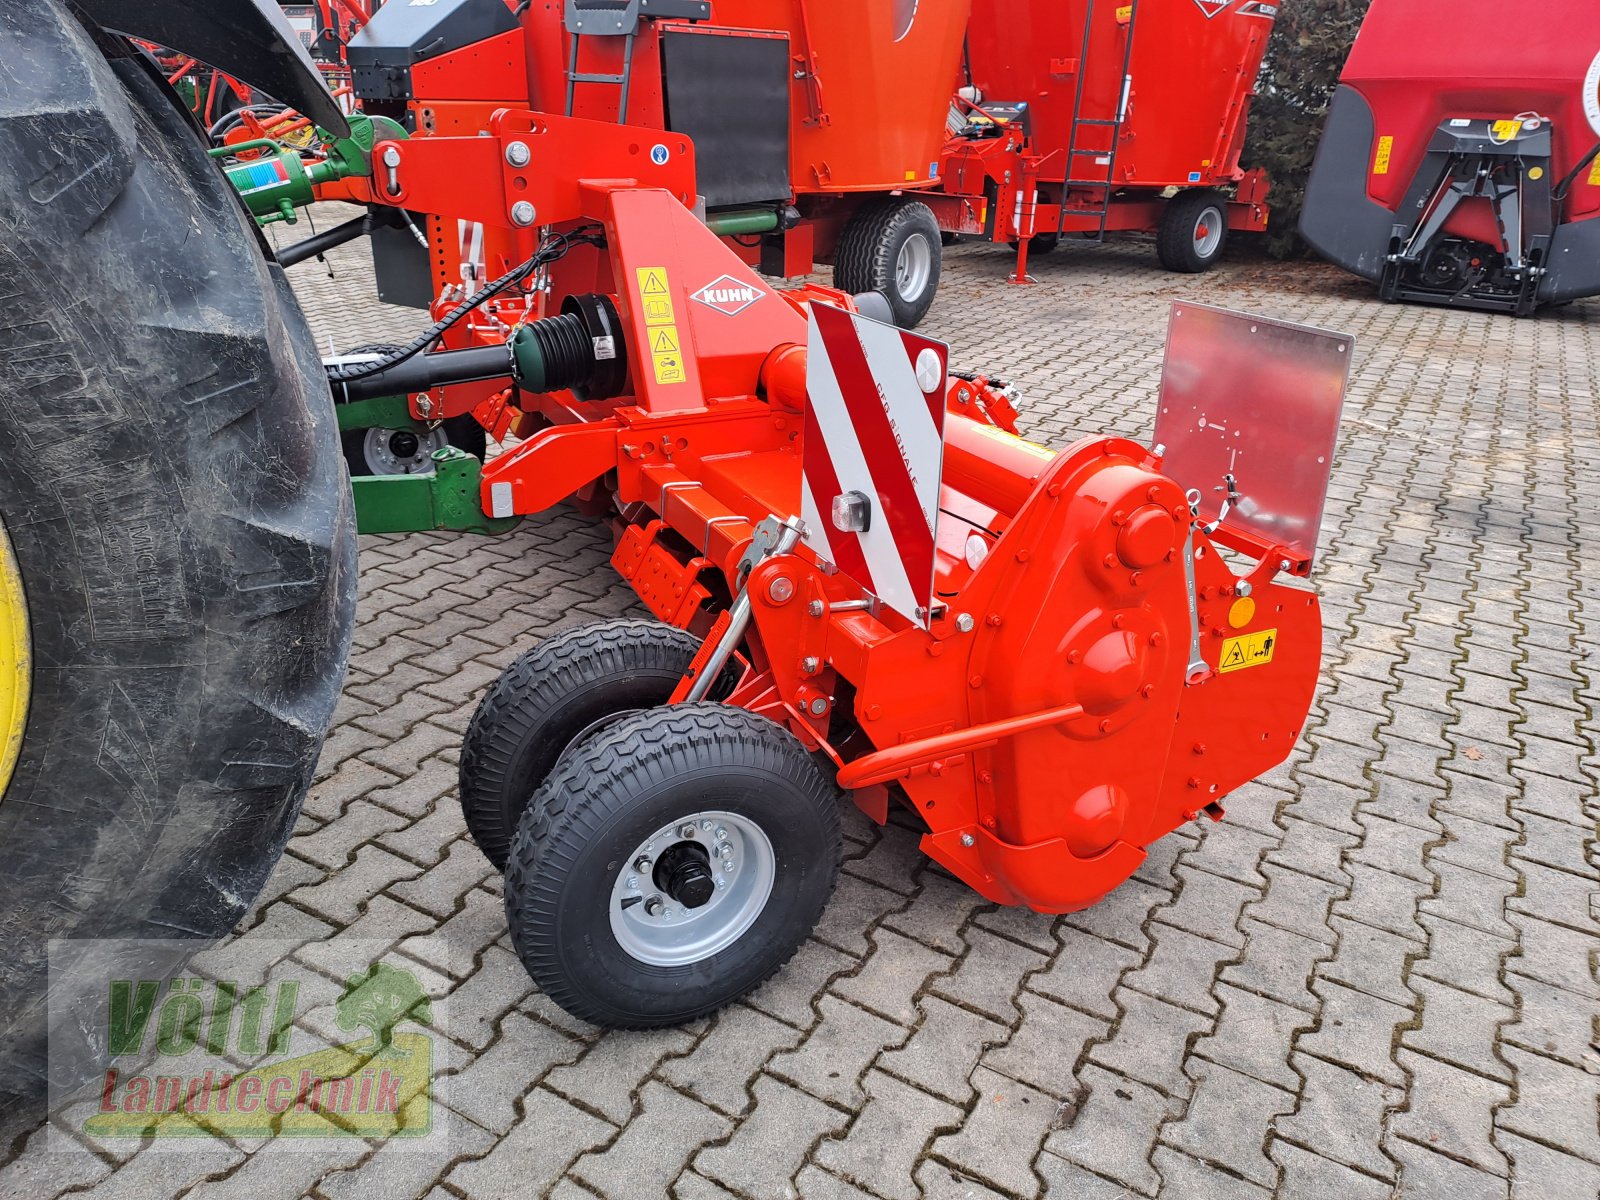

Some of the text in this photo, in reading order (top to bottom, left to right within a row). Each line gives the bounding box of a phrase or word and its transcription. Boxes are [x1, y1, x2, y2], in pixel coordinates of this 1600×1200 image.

[703, 287, 754, 303] KUHN
[889, 418, 919, 488] SIGNALE
[128, 523, 167, 630] MICHELIN
